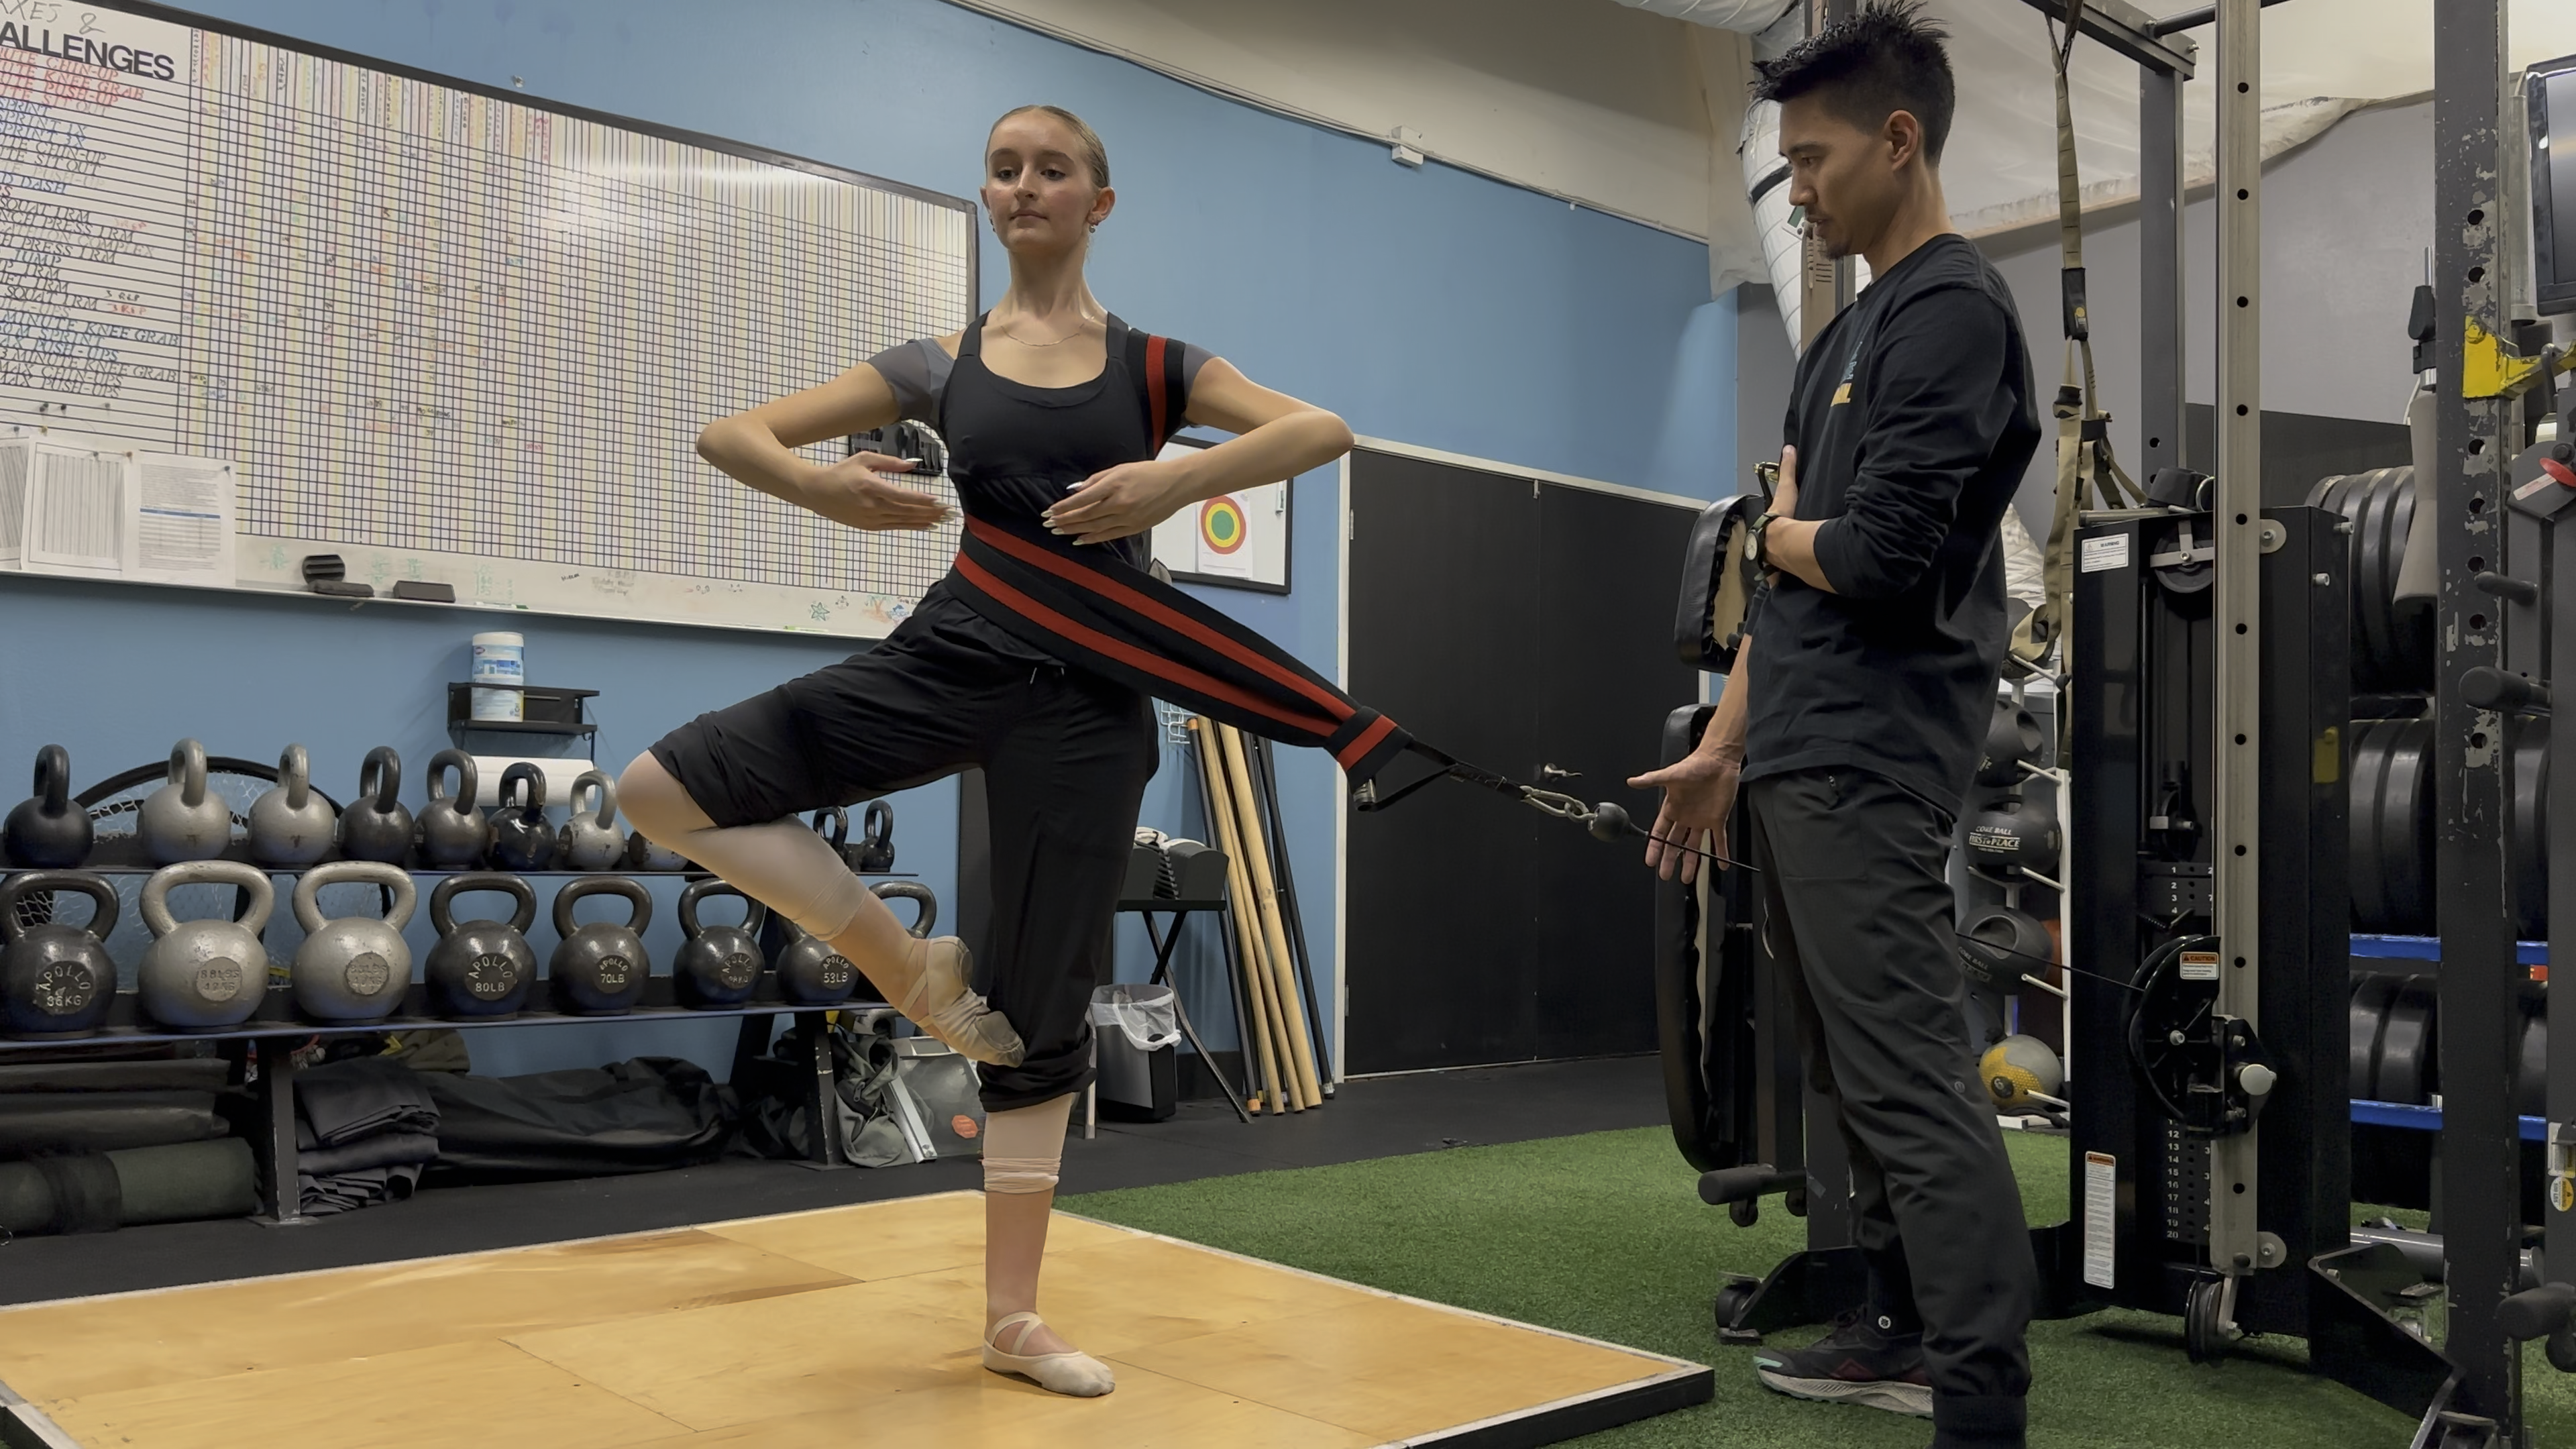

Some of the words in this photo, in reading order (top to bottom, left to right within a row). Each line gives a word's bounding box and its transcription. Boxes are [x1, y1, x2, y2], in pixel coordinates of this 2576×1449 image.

[79, 13, 106, 34] &
[0, 21, 174, 80] ALLENGES
[46, 58, 119, 80] CHIN-UP
[44, 70, 92, 88] KNEE
[98, 81, 145, 100] GRAB
[45, 82, 119, 105] PUSH-UP
[36, 140, 107, 164] CHIN-UP
[44, 215, 93, 235] PRESS
[23, 236, 73, 256] PRESS
[86, 321, 129, 339] KNEE
[134, 328, 180, 346] GRAB
[41, 366, 124, 387] CHIN-UPS
[85, 359, 130, 376] KNEE
[133, 366, 177, 382] GRAB
[42, 377, 121, 398] PUSH-UPS
[2171, 881, 2178, 890] 2
[468, 956, 513, 979] APOLLO
[599, 958, 628, 971] APOLLO
[823, 956, 849, 970] APOLLO
[36, 965, 91, 991] APOLLO
[600, 973, 625, 983] 70LB
[824, 971, 849, 983] 53LB
[475, 981, 505, 992] 80LB
[1994, 1078, 2005, 1090] 6
[2167, 1130, 2180, 1138] 12
[2167, 1143, 2180, 1151] 13
[2167, 1155, 2179, 1163] 14
[2167, 1168, 2179, 1176] 15
[2167, 1181, 2179, 1189] 16
[2167, 1206, 2179, 1214] 18
[2167, 1219, 2179, 1227] 19
[2167, 1230, 2179, 1239] 20
